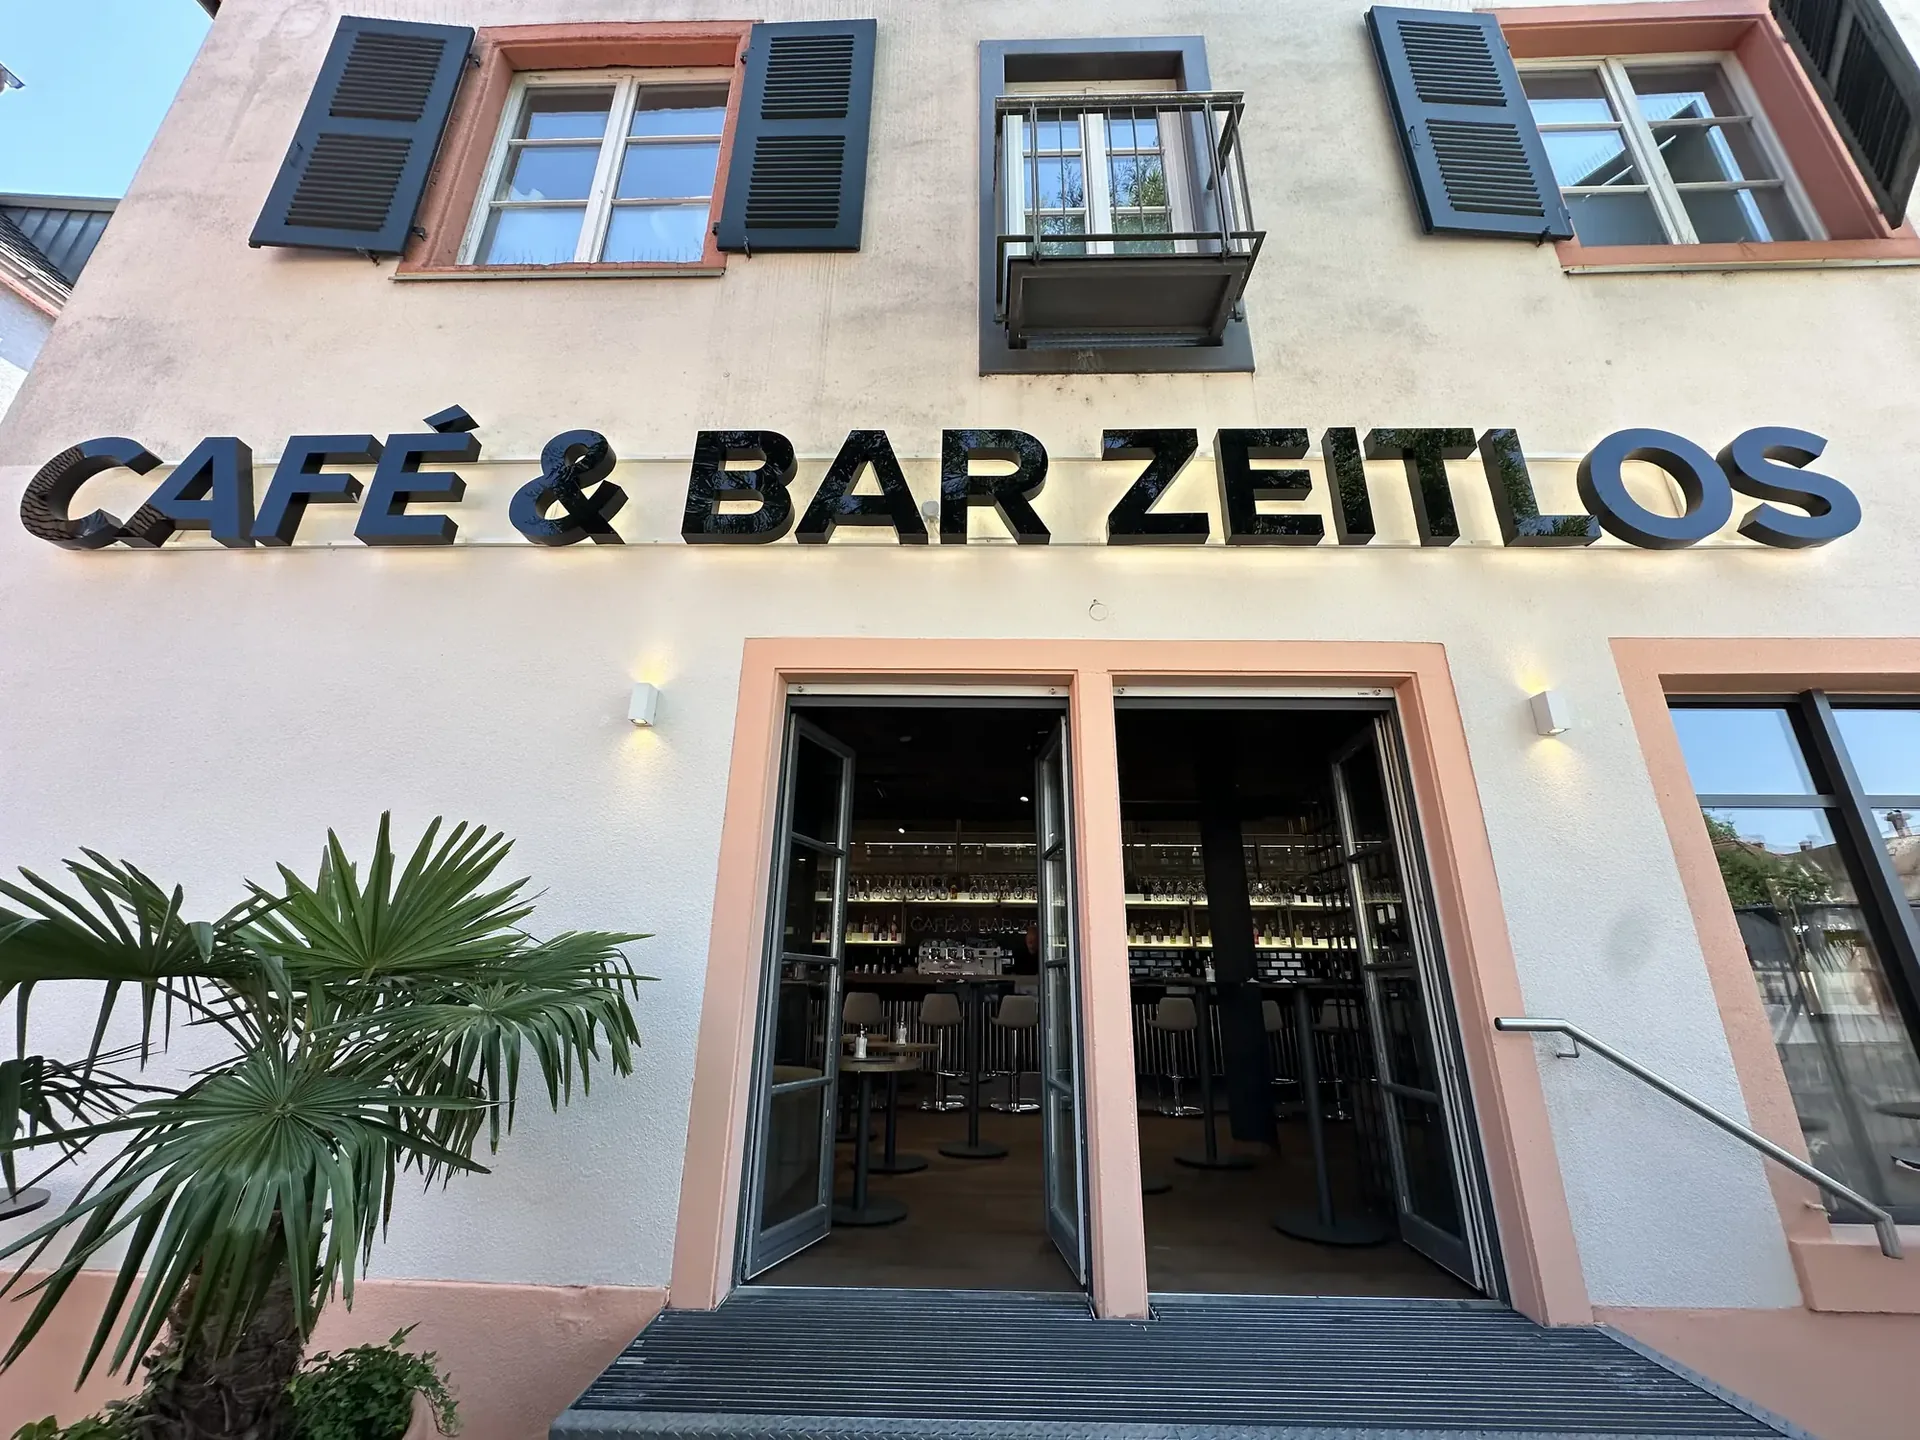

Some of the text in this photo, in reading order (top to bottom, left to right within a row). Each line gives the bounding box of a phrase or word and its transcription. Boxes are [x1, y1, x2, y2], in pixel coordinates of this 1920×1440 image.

[20, 404, 1862, 550] CAFÉ & BAR ZEITLOS
